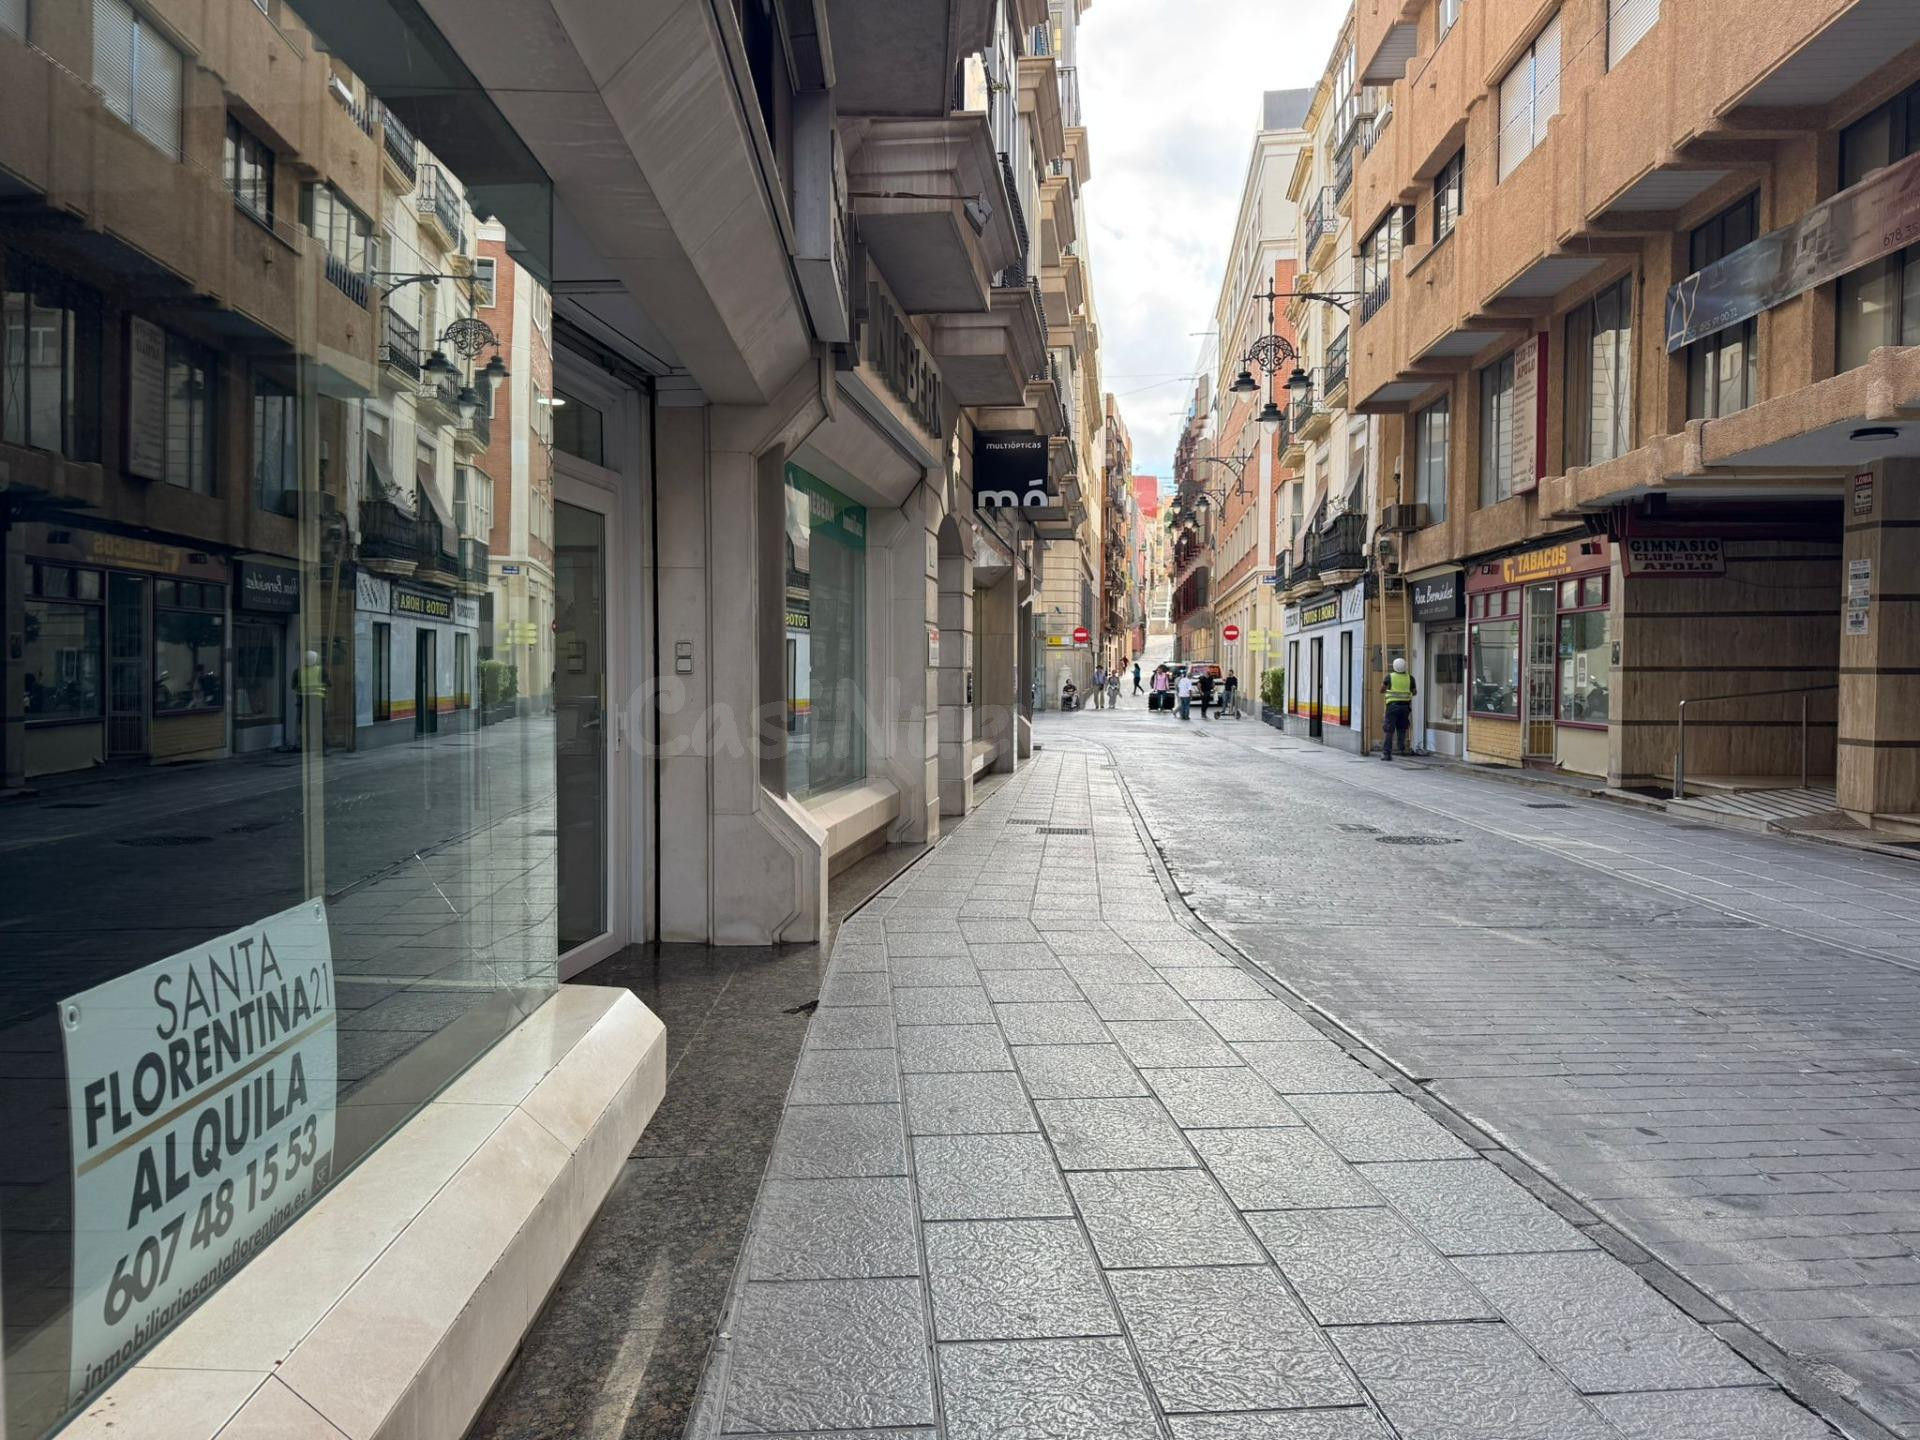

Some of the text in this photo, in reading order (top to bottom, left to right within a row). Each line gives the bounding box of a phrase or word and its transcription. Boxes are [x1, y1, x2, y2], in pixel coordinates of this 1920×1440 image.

[1518, 545, 1567, 573] TABACOS
[1630, 540, 1719, 552] GIMNASIO
[1642, 562, 1713, 570] APOLO
[154, 931, 282, 1040] SANTA
[127, 1052, 308, 1231] ALQUILA
[104, 1113, 317, 1326] 607 48 15 53
